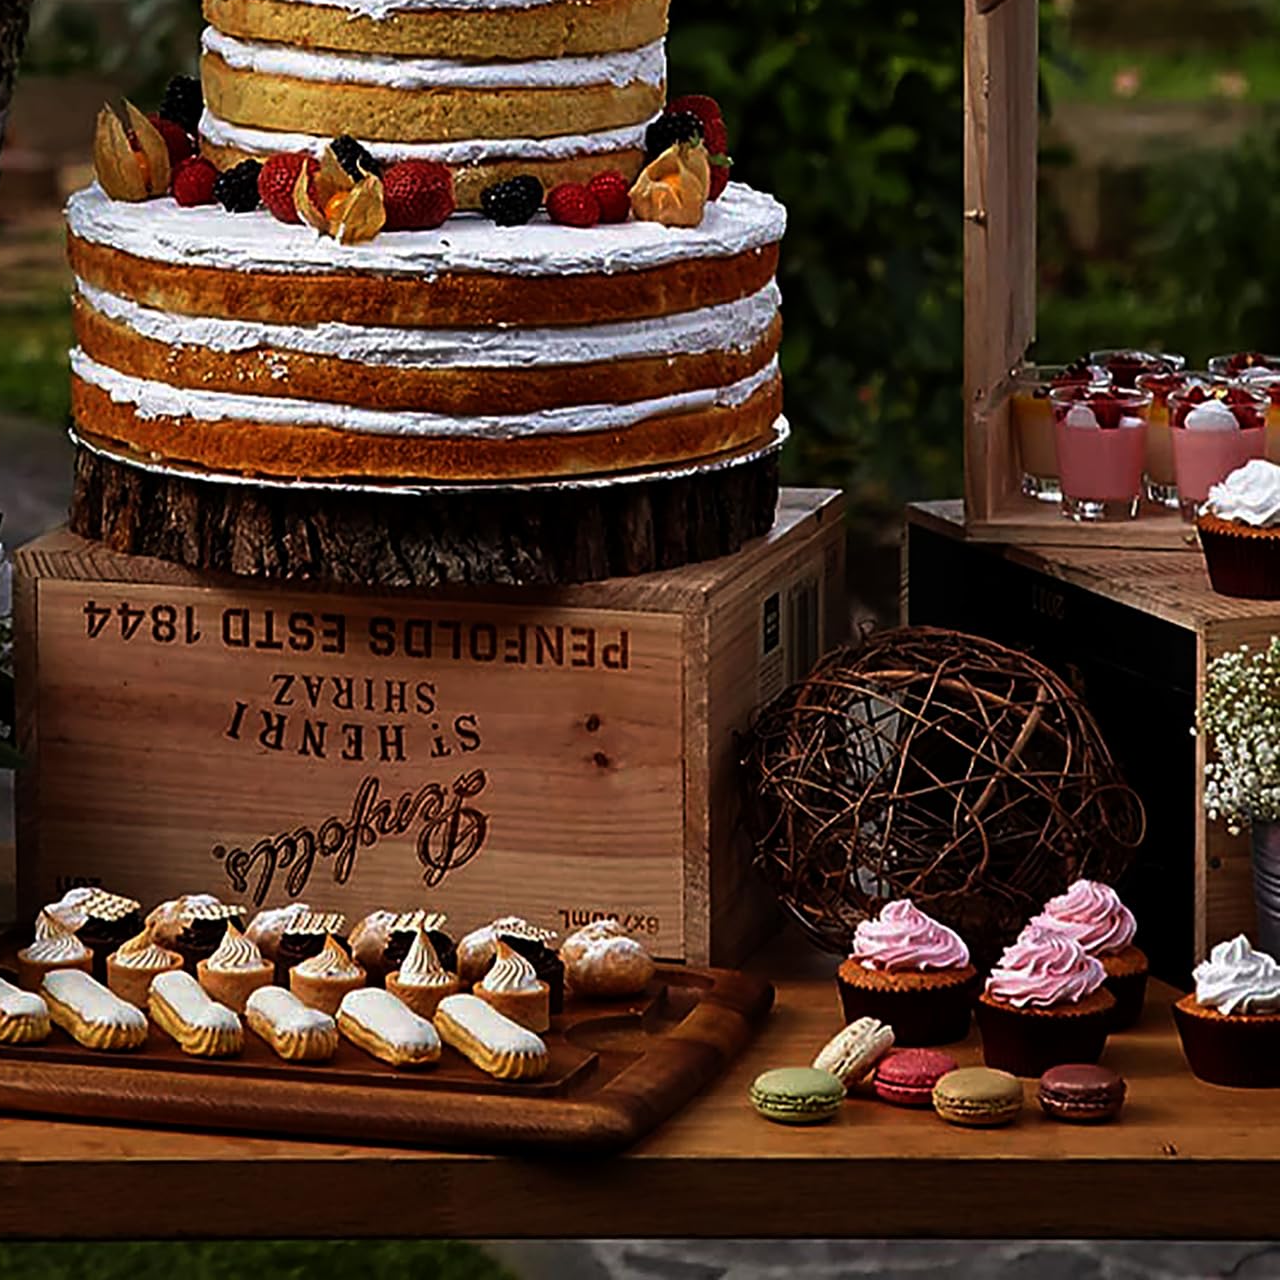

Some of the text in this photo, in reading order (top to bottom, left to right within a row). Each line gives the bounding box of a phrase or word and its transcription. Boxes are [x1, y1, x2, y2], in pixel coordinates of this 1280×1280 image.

[83, 599, 631, 670] PENFOLDS ESTD 1844
[272, 673, 437, 715] SHIRAZ
[225, 701, 407, 761] HENRI
